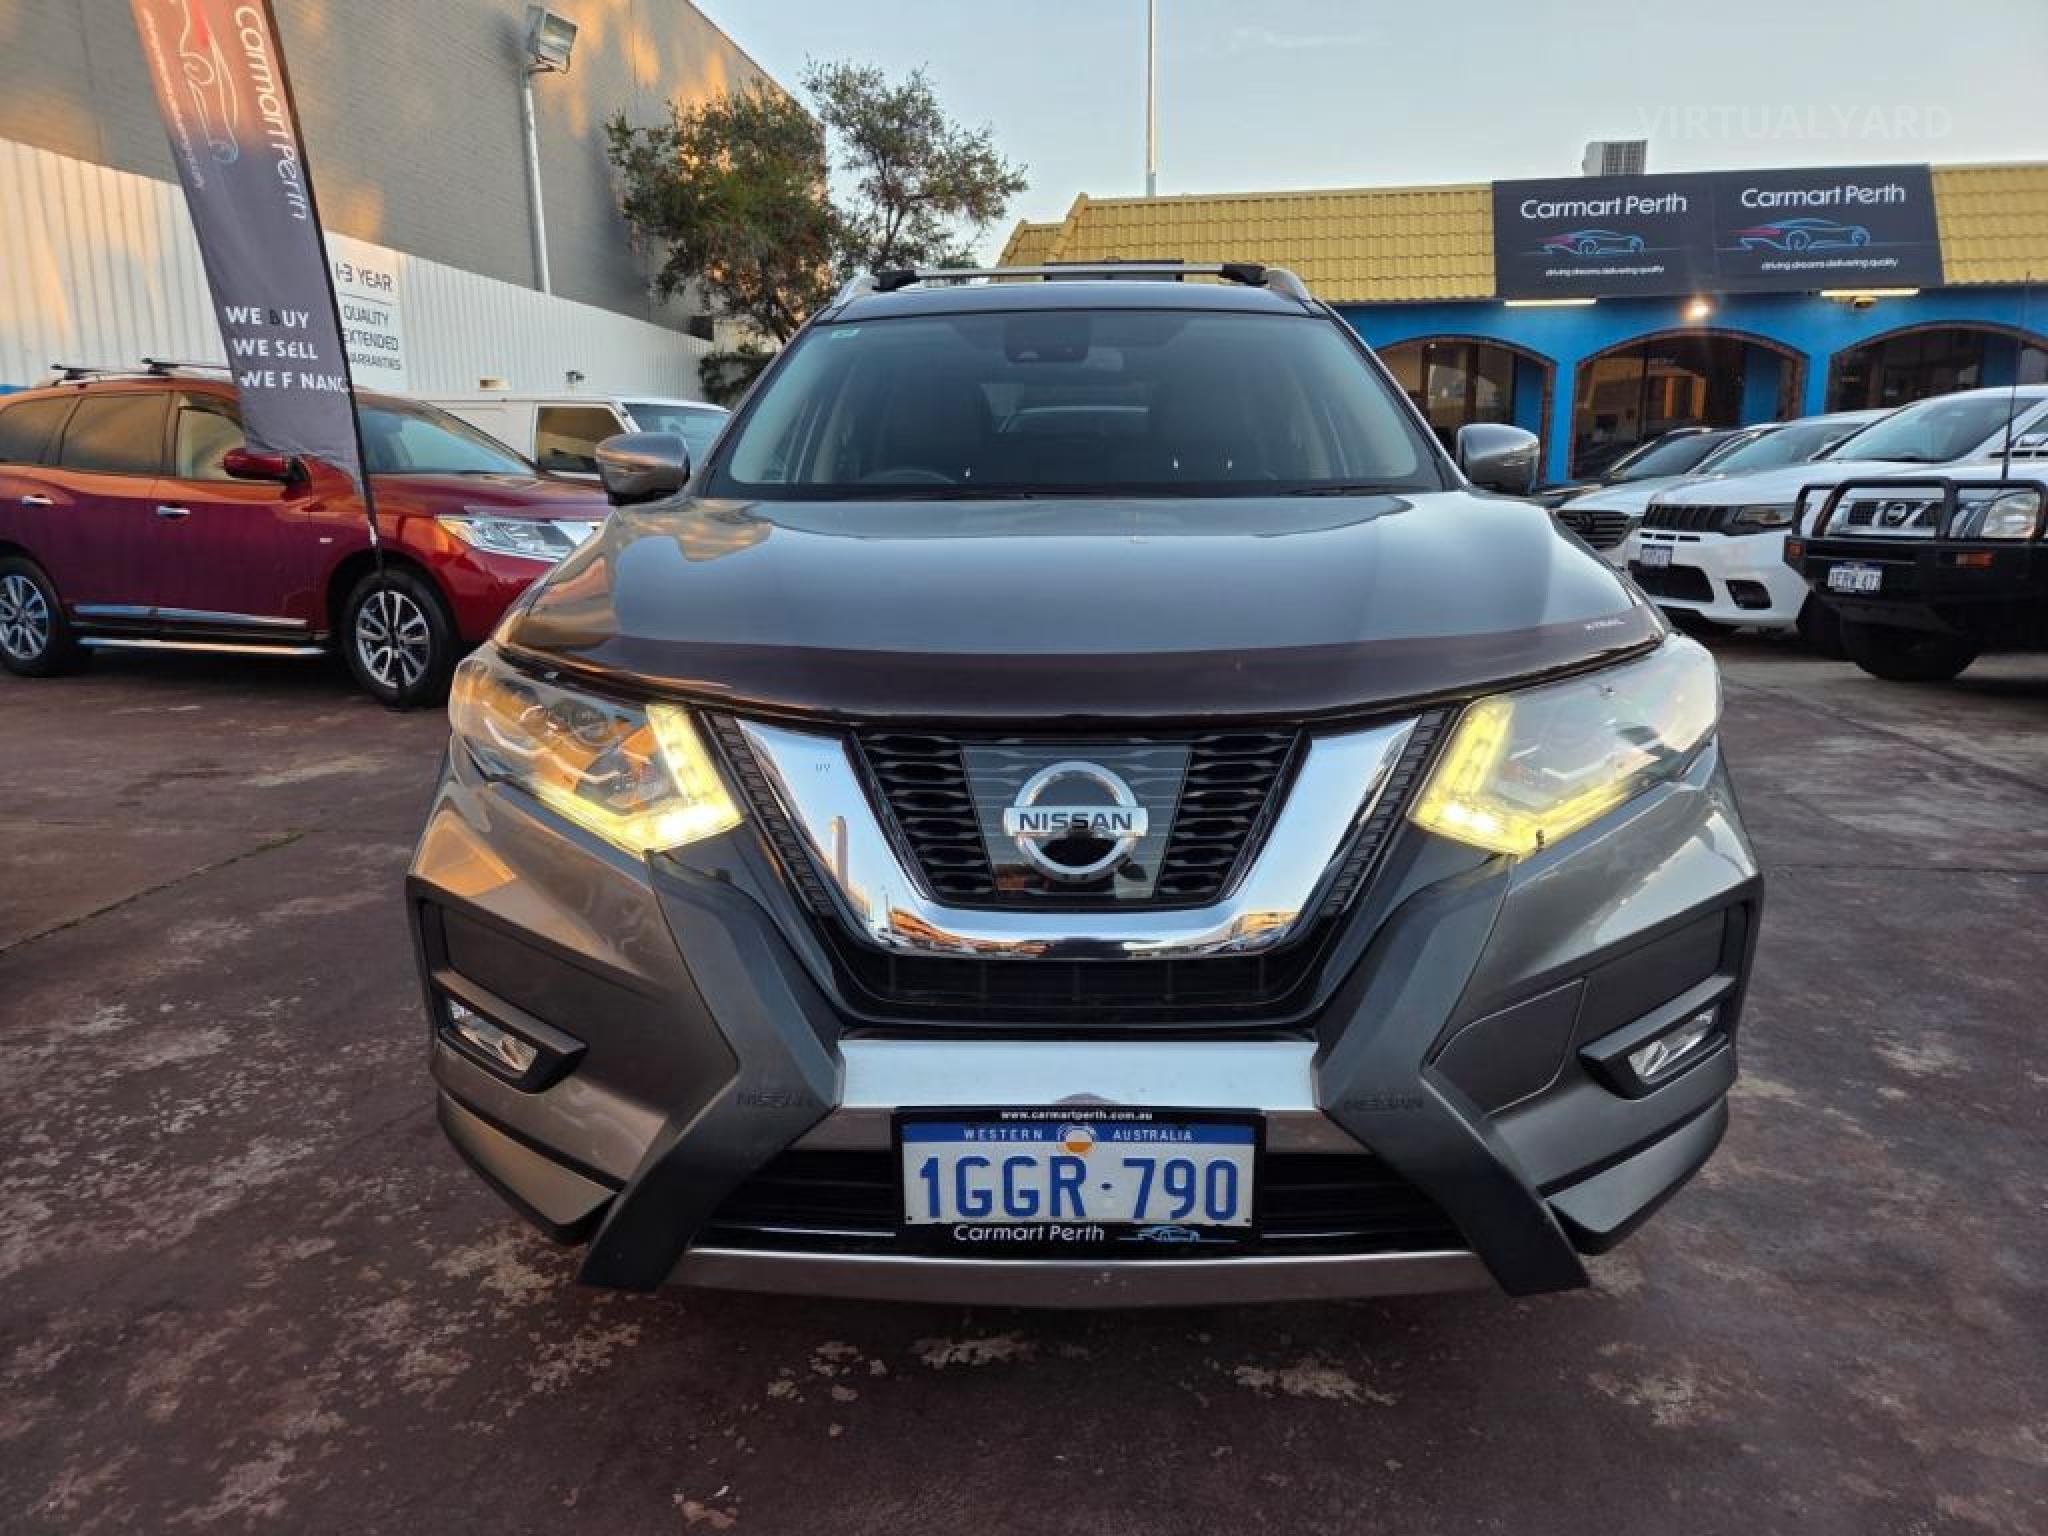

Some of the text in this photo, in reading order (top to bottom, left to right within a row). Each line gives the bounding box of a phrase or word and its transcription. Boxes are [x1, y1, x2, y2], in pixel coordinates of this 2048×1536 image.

[1741, 183, 1906, 209] Carmart Perth
[1520, 193, 1688, 220] Carmart Perth
[356, 267, 392, 292] YEAR
[225, 305, 263, 325] WE
[343, 304, 389, 328] QUALITY
[232, 338, 319, 359] WE SELL
[239, 369, 277, 389] WE
[1019, 811, 1132, 831] NISSAN
[1001, 1110, 1153, 1121] www.carmartperth.com.au
[963, 1129, 1193, 1142] WESTERN AUSTRALIA
[953, 1224, 1105, 1242] Carmart Perth
